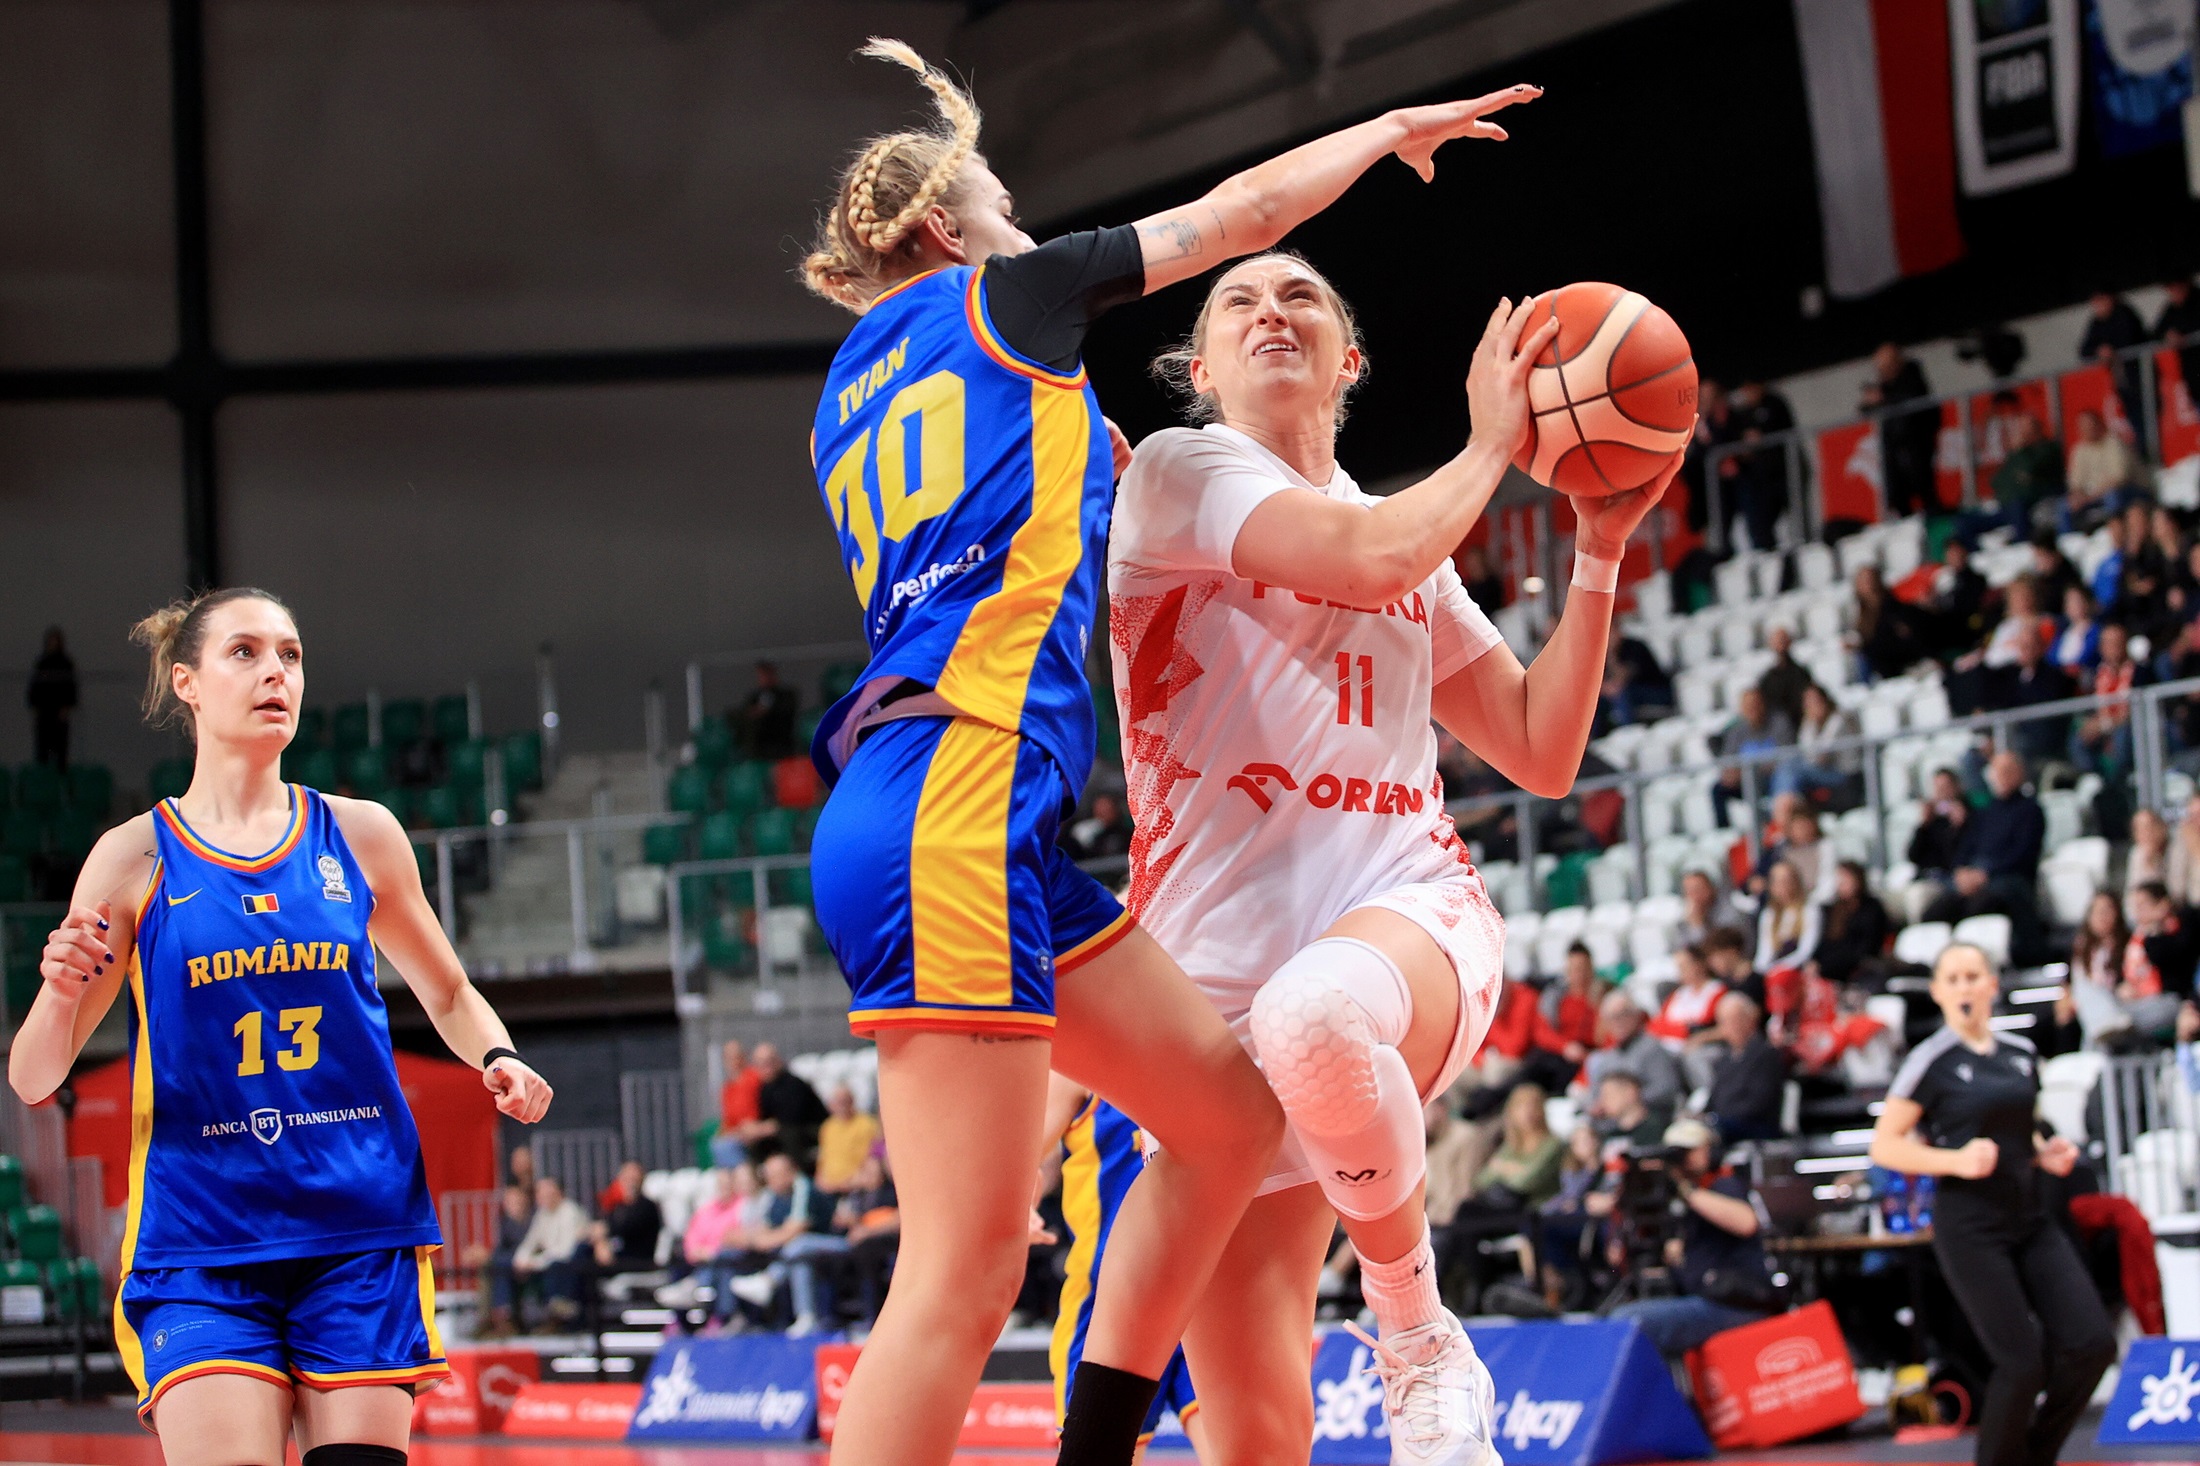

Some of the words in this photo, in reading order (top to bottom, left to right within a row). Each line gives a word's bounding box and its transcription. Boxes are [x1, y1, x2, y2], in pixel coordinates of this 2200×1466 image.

[838, 336, 910, 426] IVAN
[1334, 651, 1373, 728] 11
[187, 938, 349, 988] ROMÂNIA
[233, 1005, 323, 1077] 13
[202, 1121, 248, 1137] BANCA
[257, 1116, 276, 1130] BT
[285, 1105, 381, 1127] TRANSILVANIA
